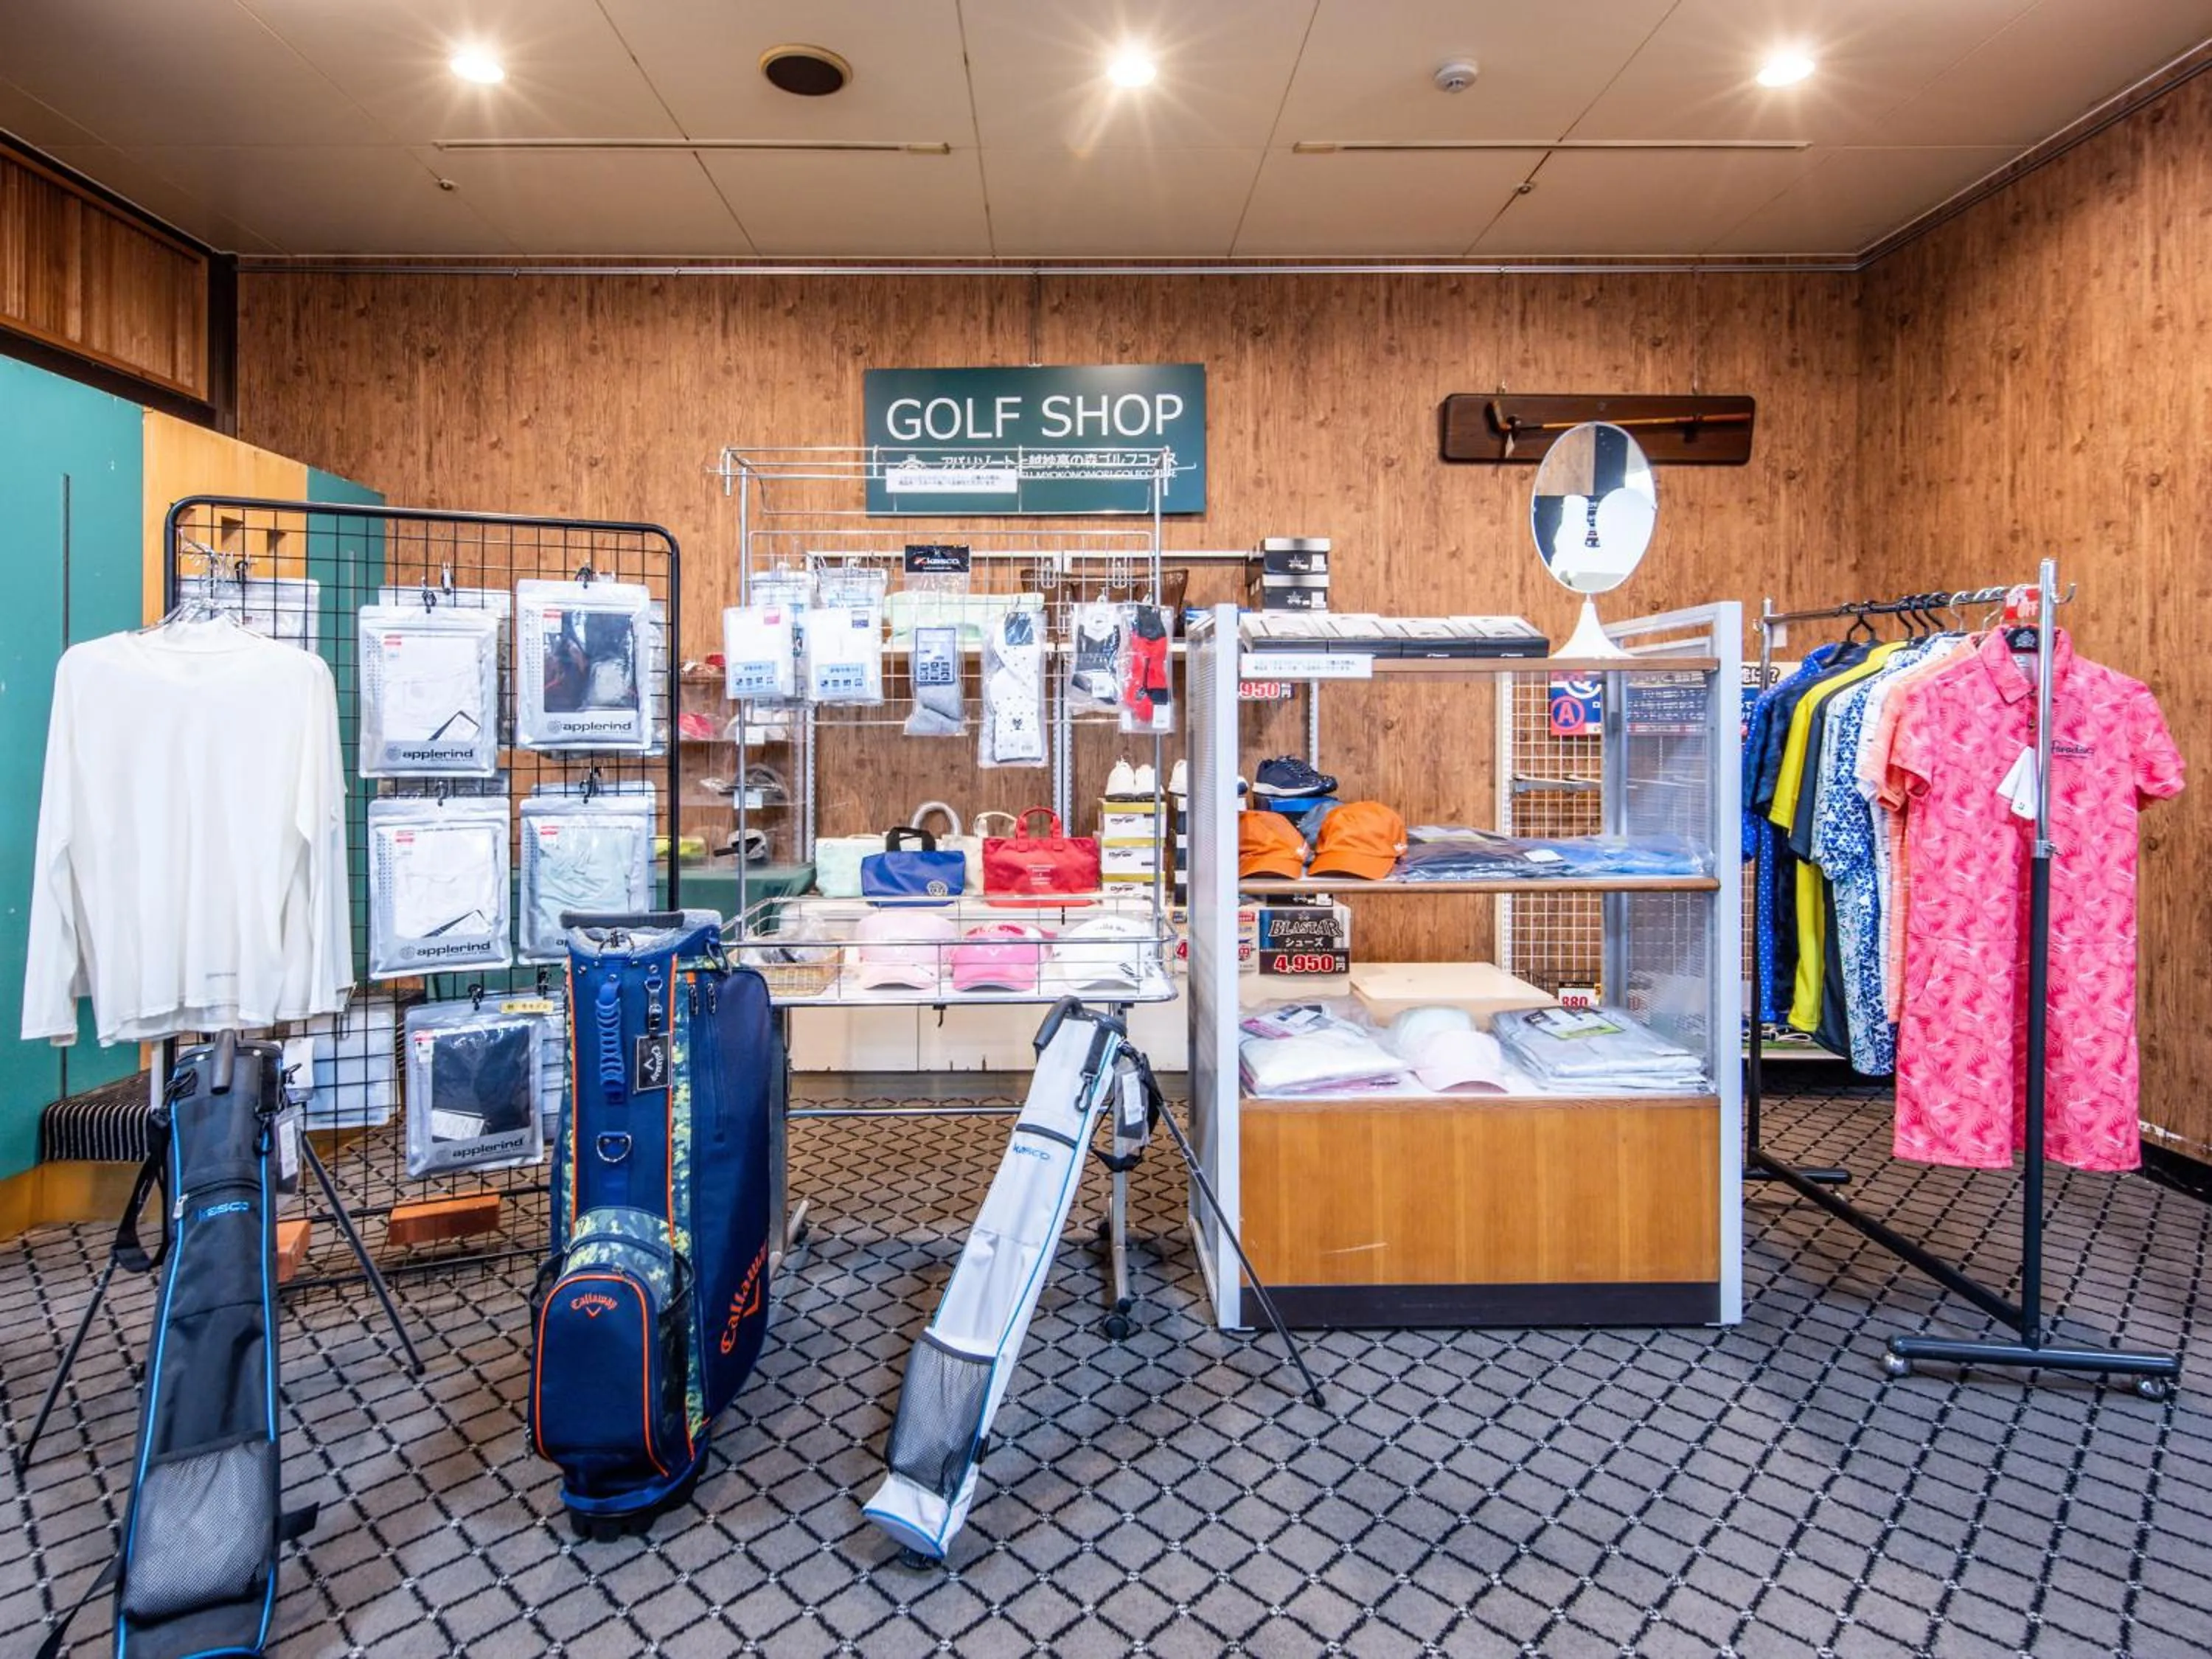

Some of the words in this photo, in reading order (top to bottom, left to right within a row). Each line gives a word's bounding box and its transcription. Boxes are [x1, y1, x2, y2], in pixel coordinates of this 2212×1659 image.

[886, 397, 1022, 440] GOLF
[1040, 394, 1183, 437] SHOP
[563, 722, 632, 732] applerind
[403, 748, 473, 760] applerind
[1268, 919, 1344, 938] BLASTAR
[417, 941, 490, 957] applerind
[1285, 937, 1324, 947] シューズ
[1274, 955, 1334, 973] 4,950
[452, 1138, 524, 1158] applerind
[571, 1292, 618, 1311] Callaway
